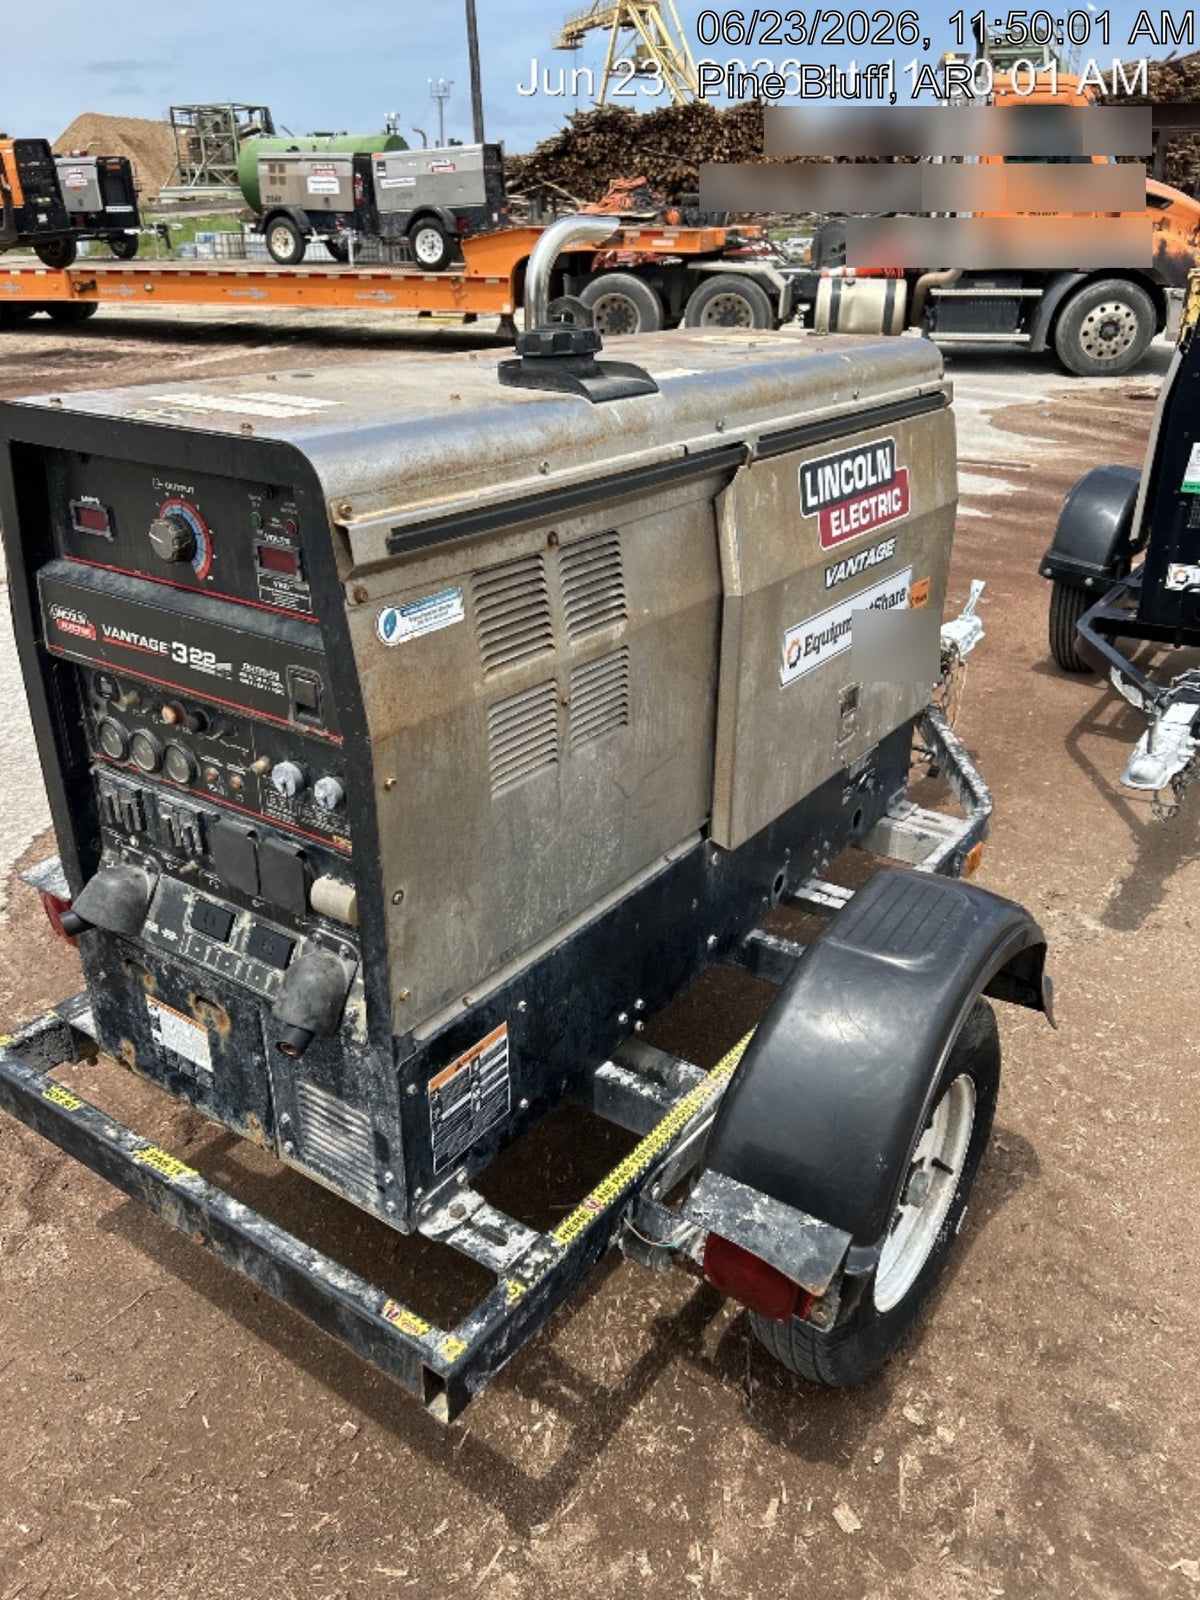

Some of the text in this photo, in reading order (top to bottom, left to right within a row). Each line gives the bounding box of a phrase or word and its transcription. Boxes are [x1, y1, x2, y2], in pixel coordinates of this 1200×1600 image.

[804, 447, 892, 507] LINCOLN
[830, 487, 902, 538] ELECTRIC
[825, 537, 897, 590] VANTAGE
[101, 623, 216, 669] VANTAGE 322
[560, 1211, 589, 1240] HERE
